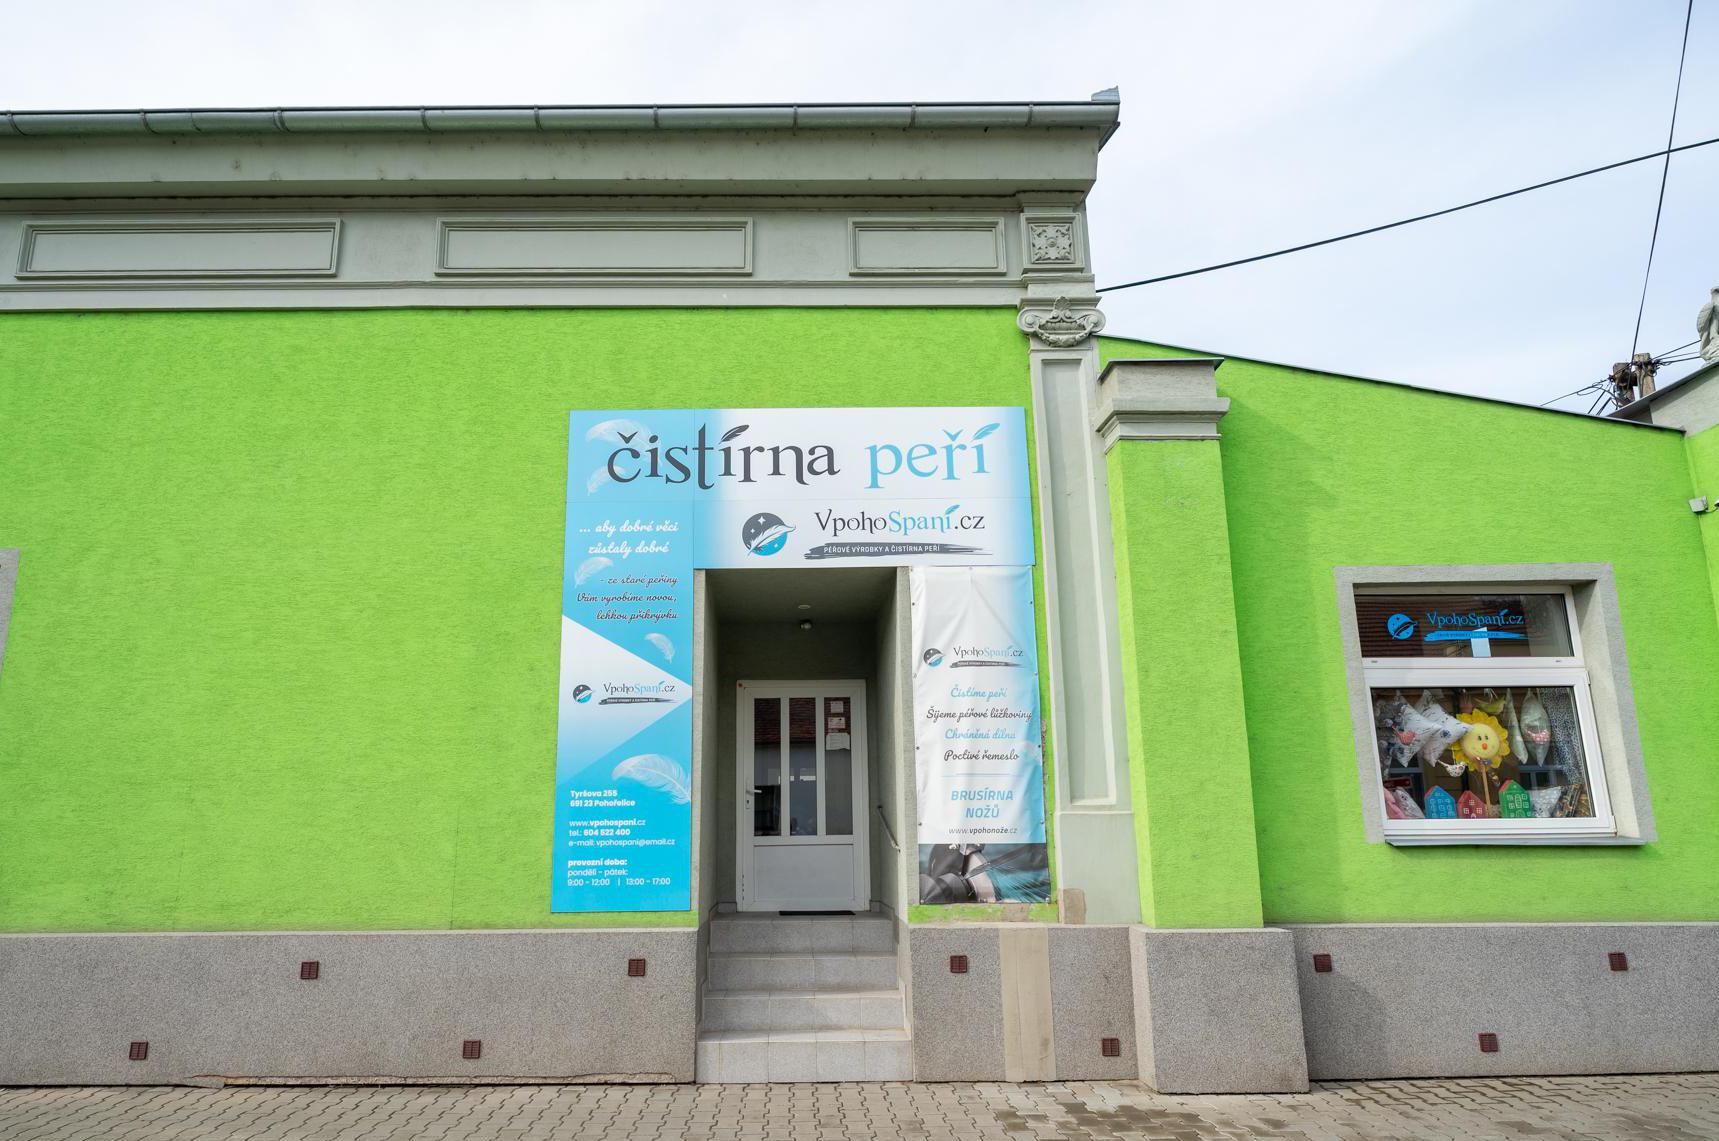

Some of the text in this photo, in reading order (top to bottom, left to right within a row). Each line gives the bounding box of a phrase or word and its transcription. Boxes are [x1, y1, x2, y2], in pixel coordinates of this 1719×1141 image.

[607, 423, 1000, 490] čistírna peří
[815, 505, 985, 537] VpohoSpaní.cz
[595, 520, 616, 538] aby
[619, 520, 654, 532] dobré
[656, 520, 679, 532] věci
[588, 541, 670, 559] zůstaly dobré
[824, 544, 850, 553] PÉŘOVÉ
[851, 544, 882, 553] VÝROBKY
[891, 544, 923, 552] ČISTÍRNA
[924, 544, 940, 552] PEŘÍ
[621, 574, 647, 584] staré
[645, 574, 678, 588] peřiny
[577, 593, 598, 602] Vám
[601, 592, 644, 606] vyrobíme
[597, 609, 678, 624] lehkou přikrývku
[1426, 609, 1526, 628] VpohoSpaní.cz
[953, 645, 1024, 659] VpohoSpaní.cz
[603, 681, 676, 695] VpohoSpaní.cz
[951, 684, 1008, 702] Čistíme peří
[926, 706, 1032, 723] Šijeme péřové lůžkoviny
[945, 728, 991, 739] Chráněná
[944, 749, 1019, 761] Poctivé řemeslo
[570, 790, 602, 799] Tyršova
[951, 787, 1014, 801] BRUSÍRNA
[594, 799, 636, 807] Pohořelice
[965, 804, 1000, 818] NOŽŮ
[583, 829, 600, 837] 604
[615, 828, 631, 836] 400
[567, 858, 628, 868] provozní doba:
